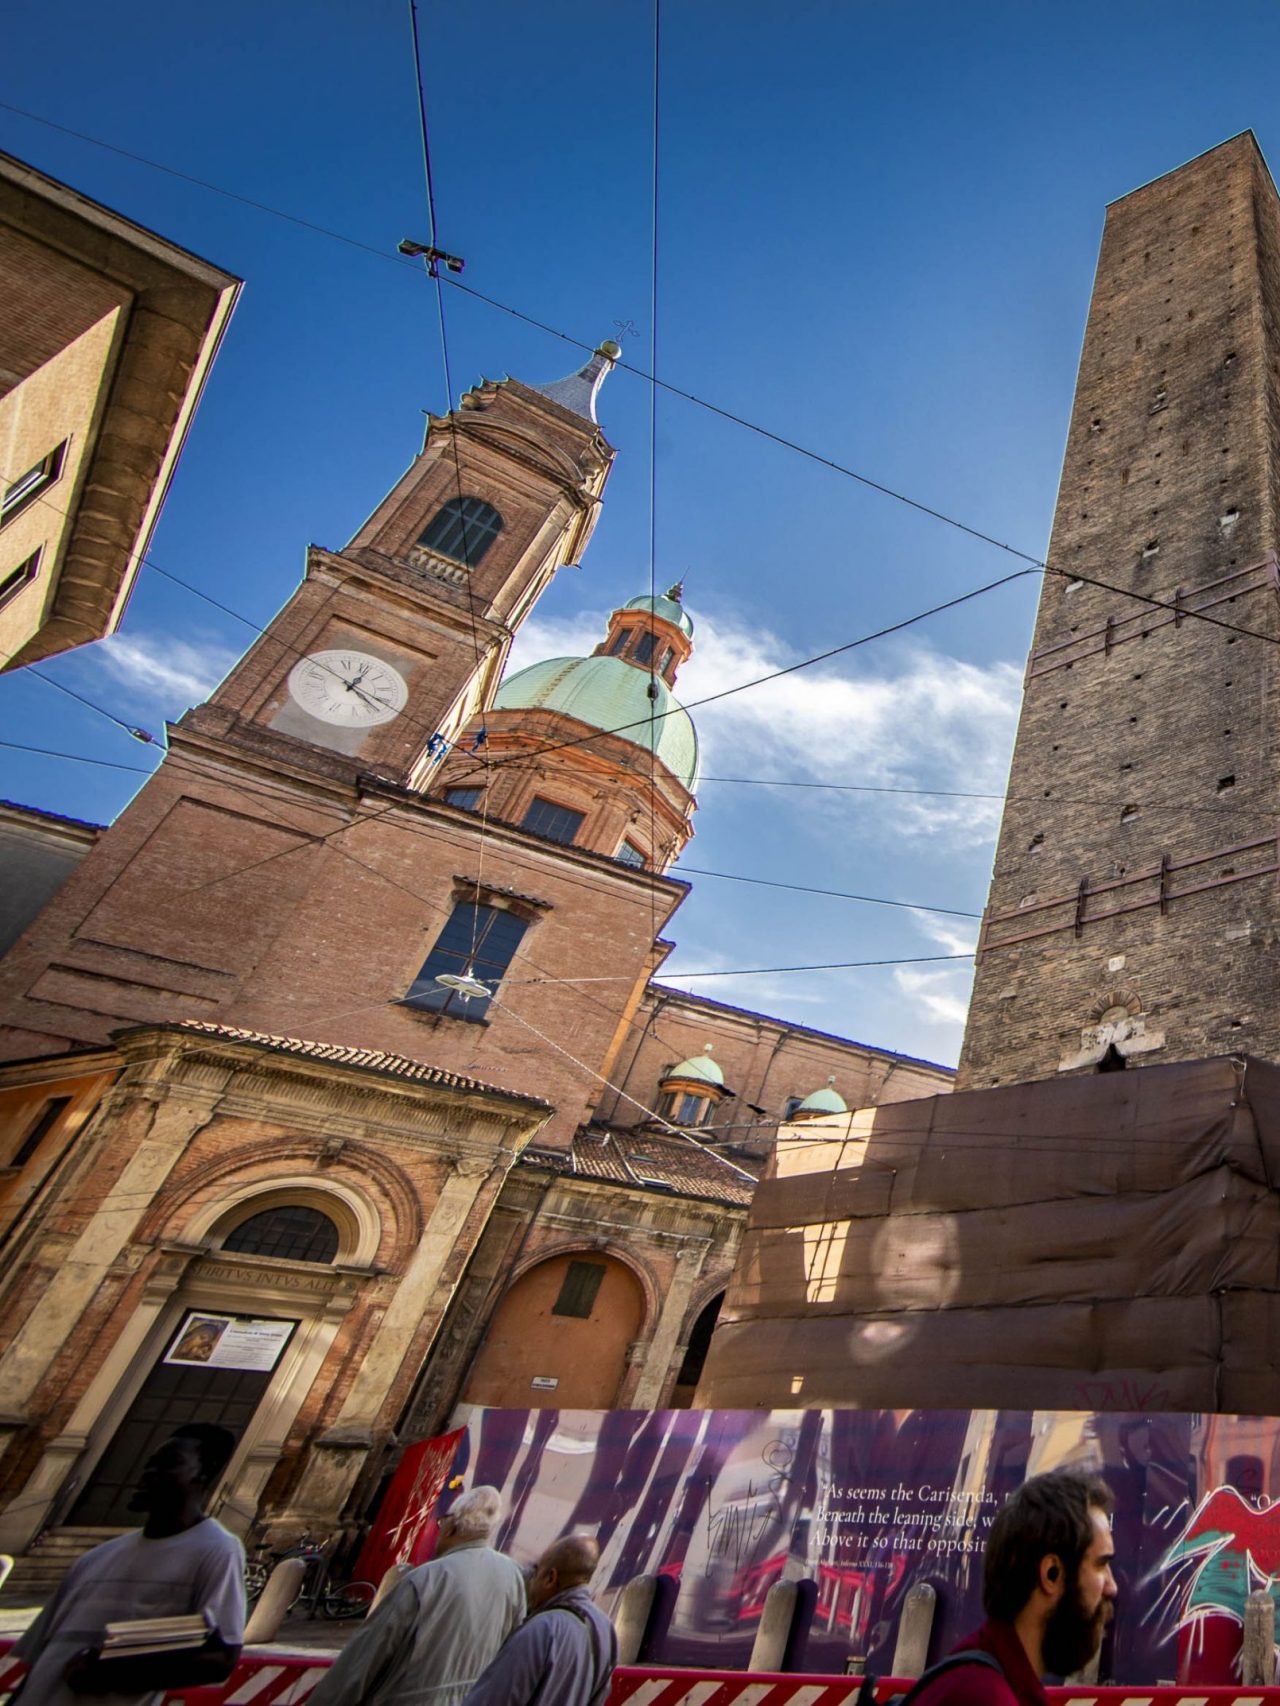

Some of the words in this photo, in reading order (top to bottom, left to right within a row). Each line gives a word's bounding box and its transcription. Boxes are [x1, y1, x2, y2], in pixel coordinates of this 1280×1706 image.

[255, 1272, 300, 1288] INTVS
[303, 1279, 336, 1292] ALIT
[846, 1489, 886, 1500] seems
[890, 1483, 914, 1501] the
[918, 1484, 998, 1506] Carisenda,
[816, 1506, 865, 1524] Beneath
[868, 1507, 890, 1525] the
[893, 1507, 942, 1532] leaning
[945, 1511, 977, 1529] side,
[809, 1528, 853, 1548] Above
[857, 1531, 868, 1548] it
[872, 1535, 888, 1549] so
[893, 1531, 923, 1550] that
[928, 1537, 989, 1557] opposit
